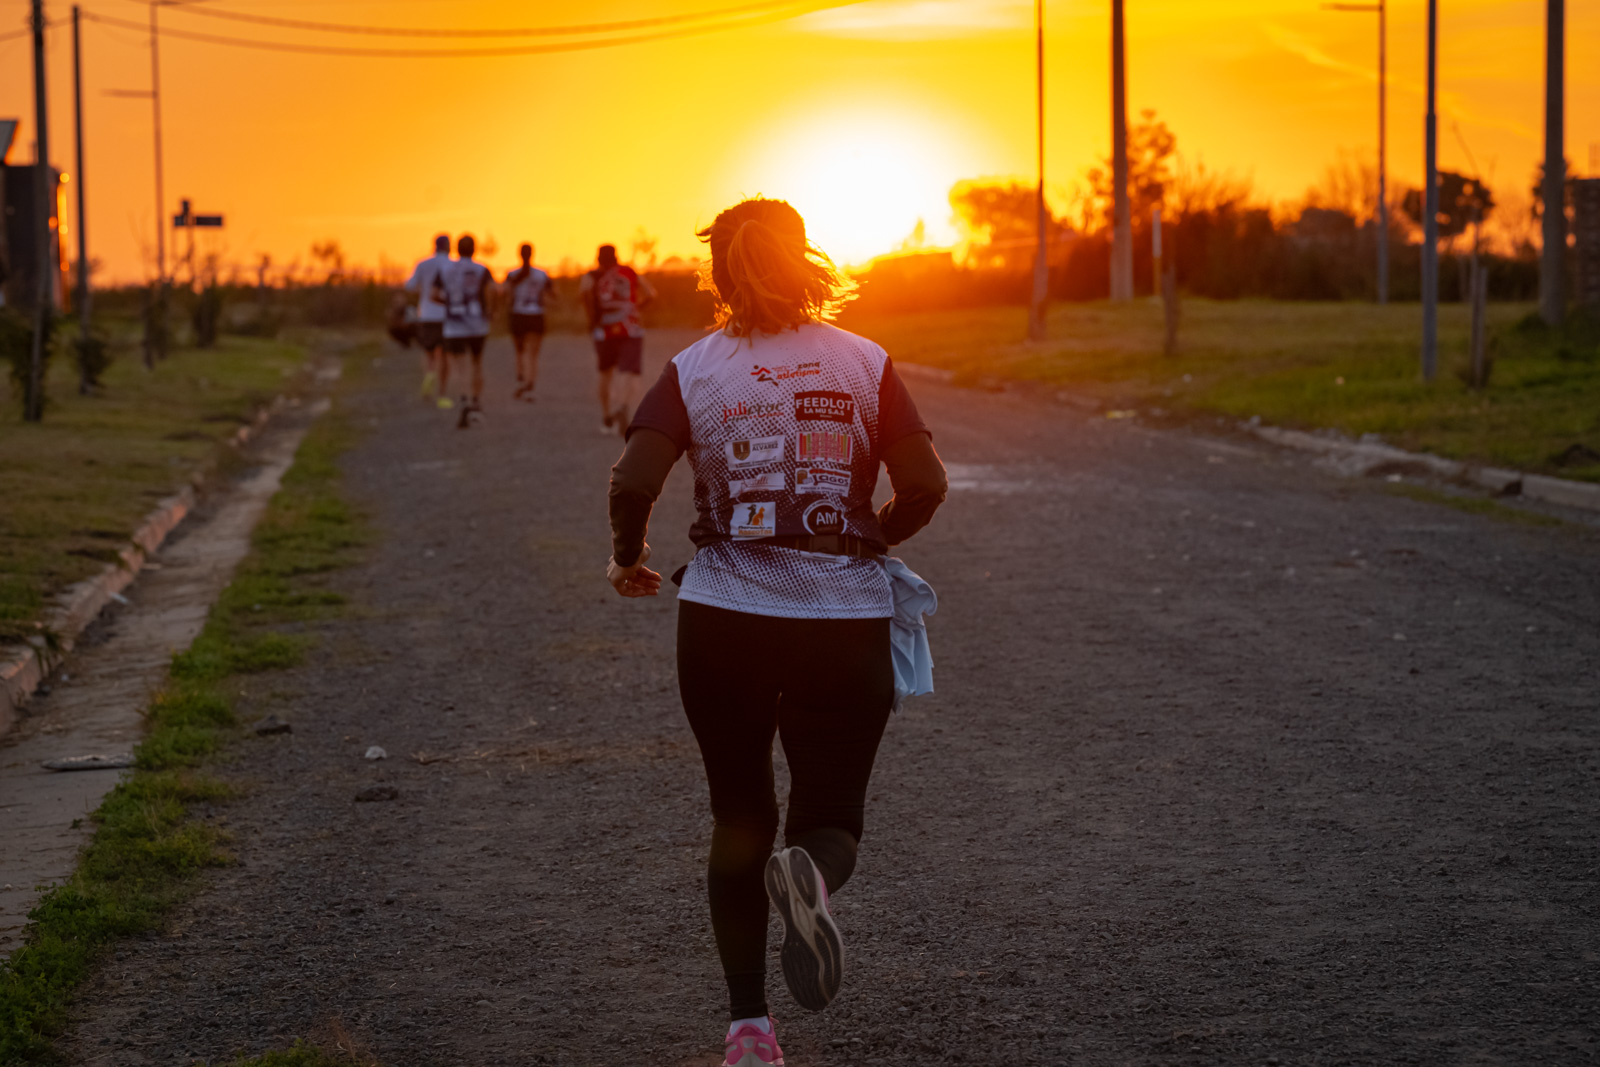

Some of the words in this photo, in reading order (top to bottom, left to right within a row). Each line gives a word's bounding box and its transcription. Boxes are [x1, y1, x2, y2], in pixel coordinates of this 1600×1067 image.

[795, 397, 853, 411] FEEDLOT
[752, 443, 778, 451] ALVAREZ
[816, 511, 838, 526] AM
